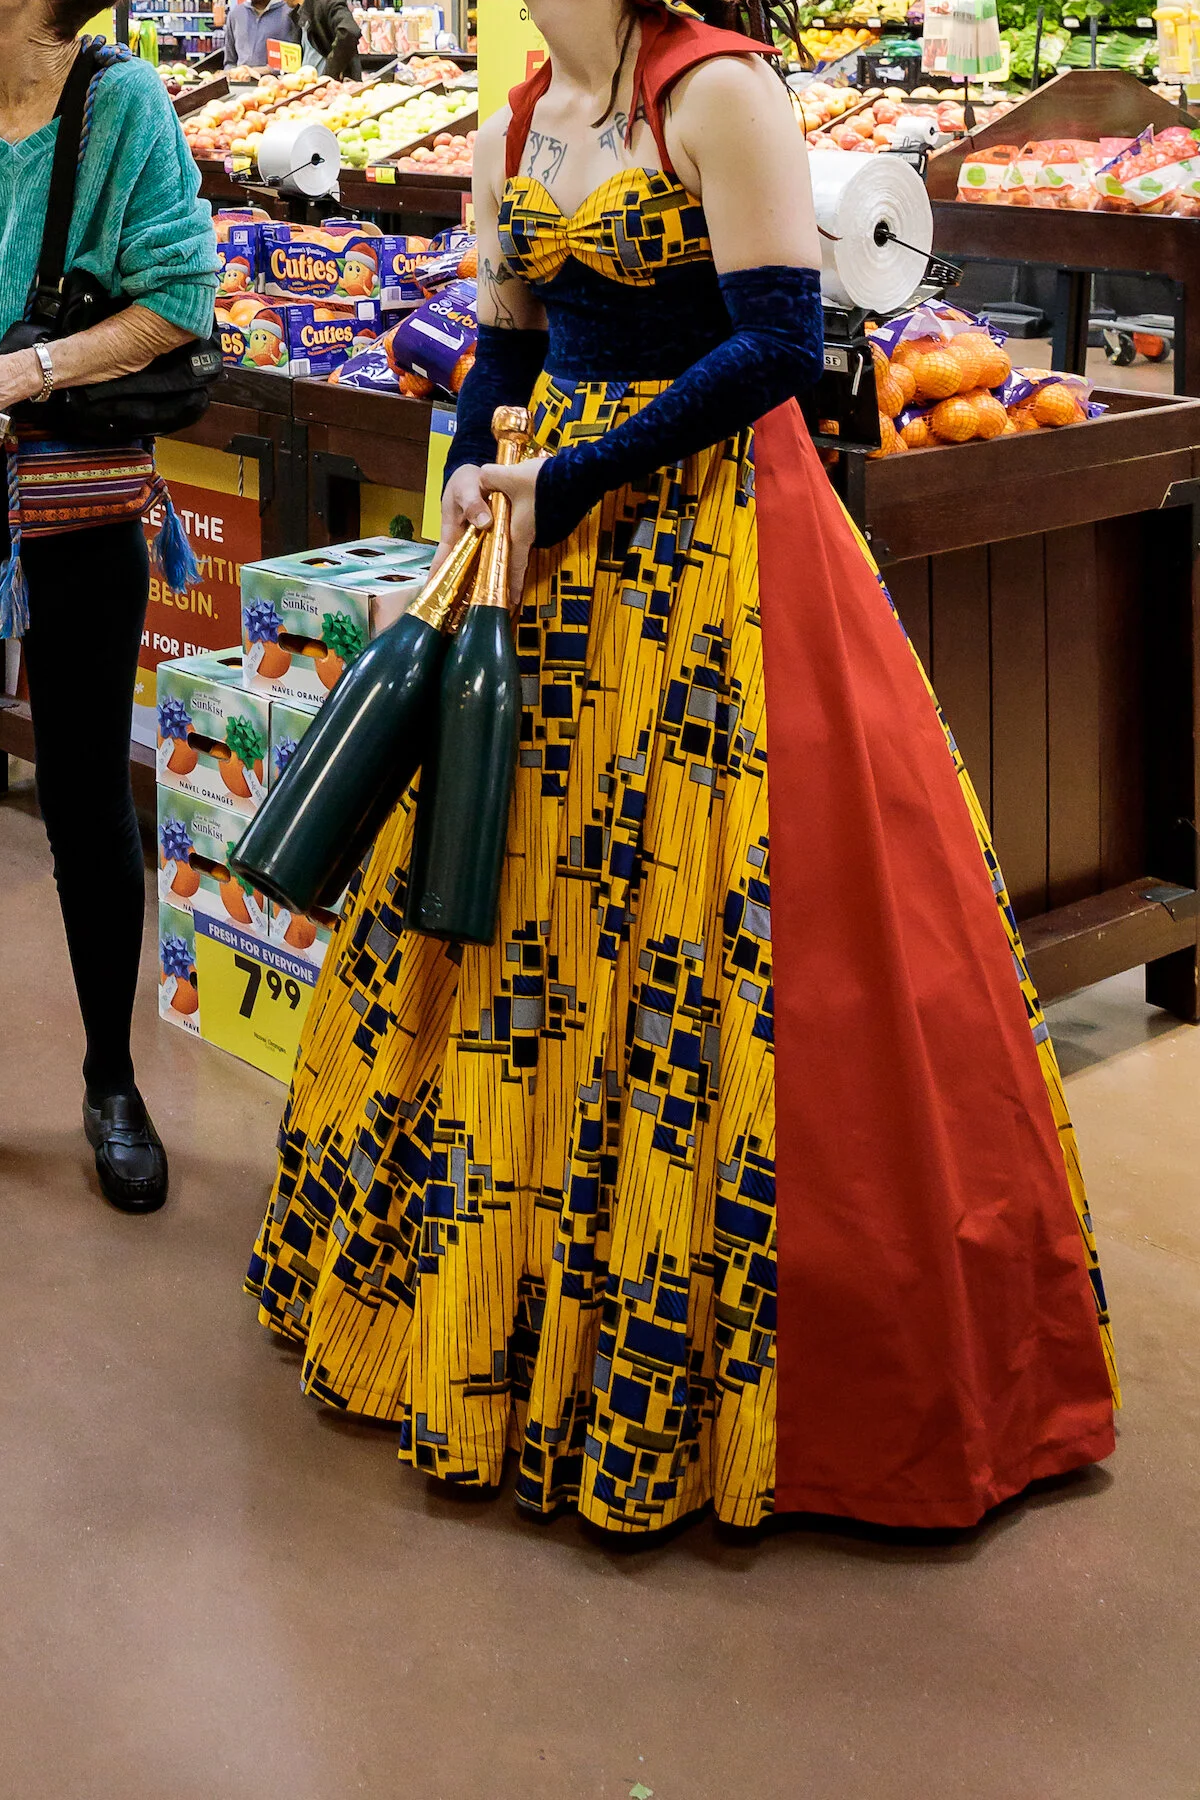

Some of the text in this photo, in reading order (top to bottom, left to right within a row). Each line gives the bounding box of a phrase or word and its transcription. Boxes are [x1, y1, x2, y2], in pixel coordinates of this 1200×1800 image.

[270, 248, 339, 284] Cuties
[301, 325, 353, 348] Cuties
[181, 510, 224, 543] THE
[148, 576, 219, 620] BEGIN.
[282, 598, 319, 616] Sunkist
[153, 633, 180, 657] FOR
[272, 685, 294, 697] NAVEL
[191, 699, 224, 718] Sunkist
[179, 781, 234, 806] NAVEL ORANGES
[192, 822, 224, 843] Sunkist
[208, 923, 238, 947] FRESH
[240, 940, 260, 957] FOR
